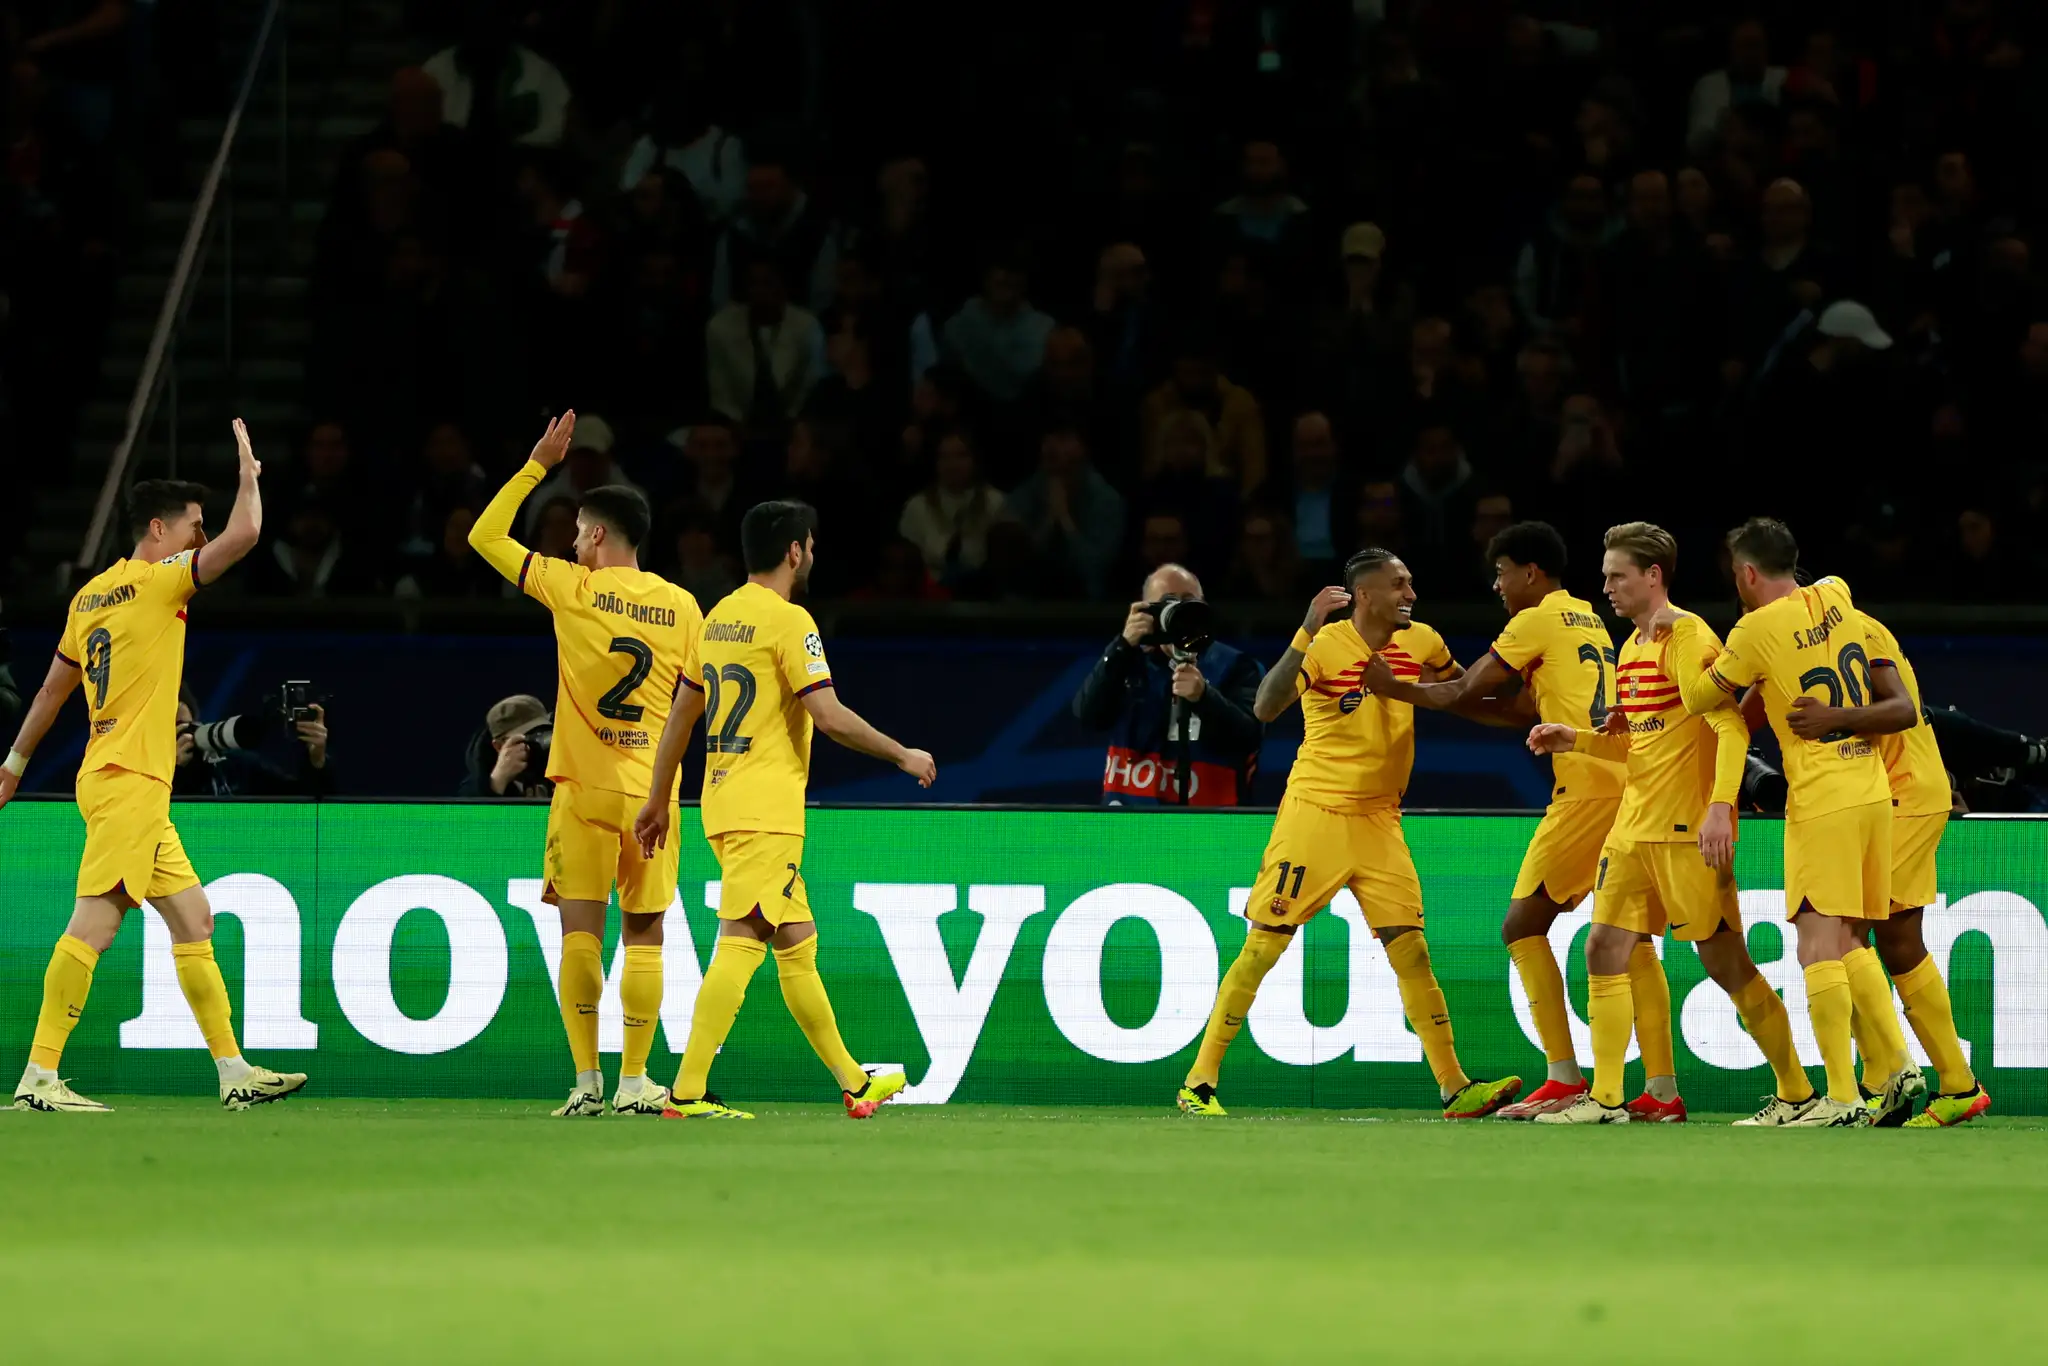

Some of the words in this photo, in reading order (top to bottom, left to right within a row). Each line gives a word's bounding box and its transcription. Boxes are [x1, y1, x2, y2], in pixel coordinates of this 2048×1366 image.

[592, 590, 624, 615] JOÃO
[626, 602, 675, 628] CANCELO
[85, 627, 111, 710] 9
[597, 637, 653, 722] 2
[618, 730, 648, 738] UNHCR
[701, 662, 756, 754] 22
[619, 738, 650, 746] ACNUR
[1275, 861, 1307, 899] 11
[120, 872, 723, 1054] now
[853, 882, 1423, 1104] you
